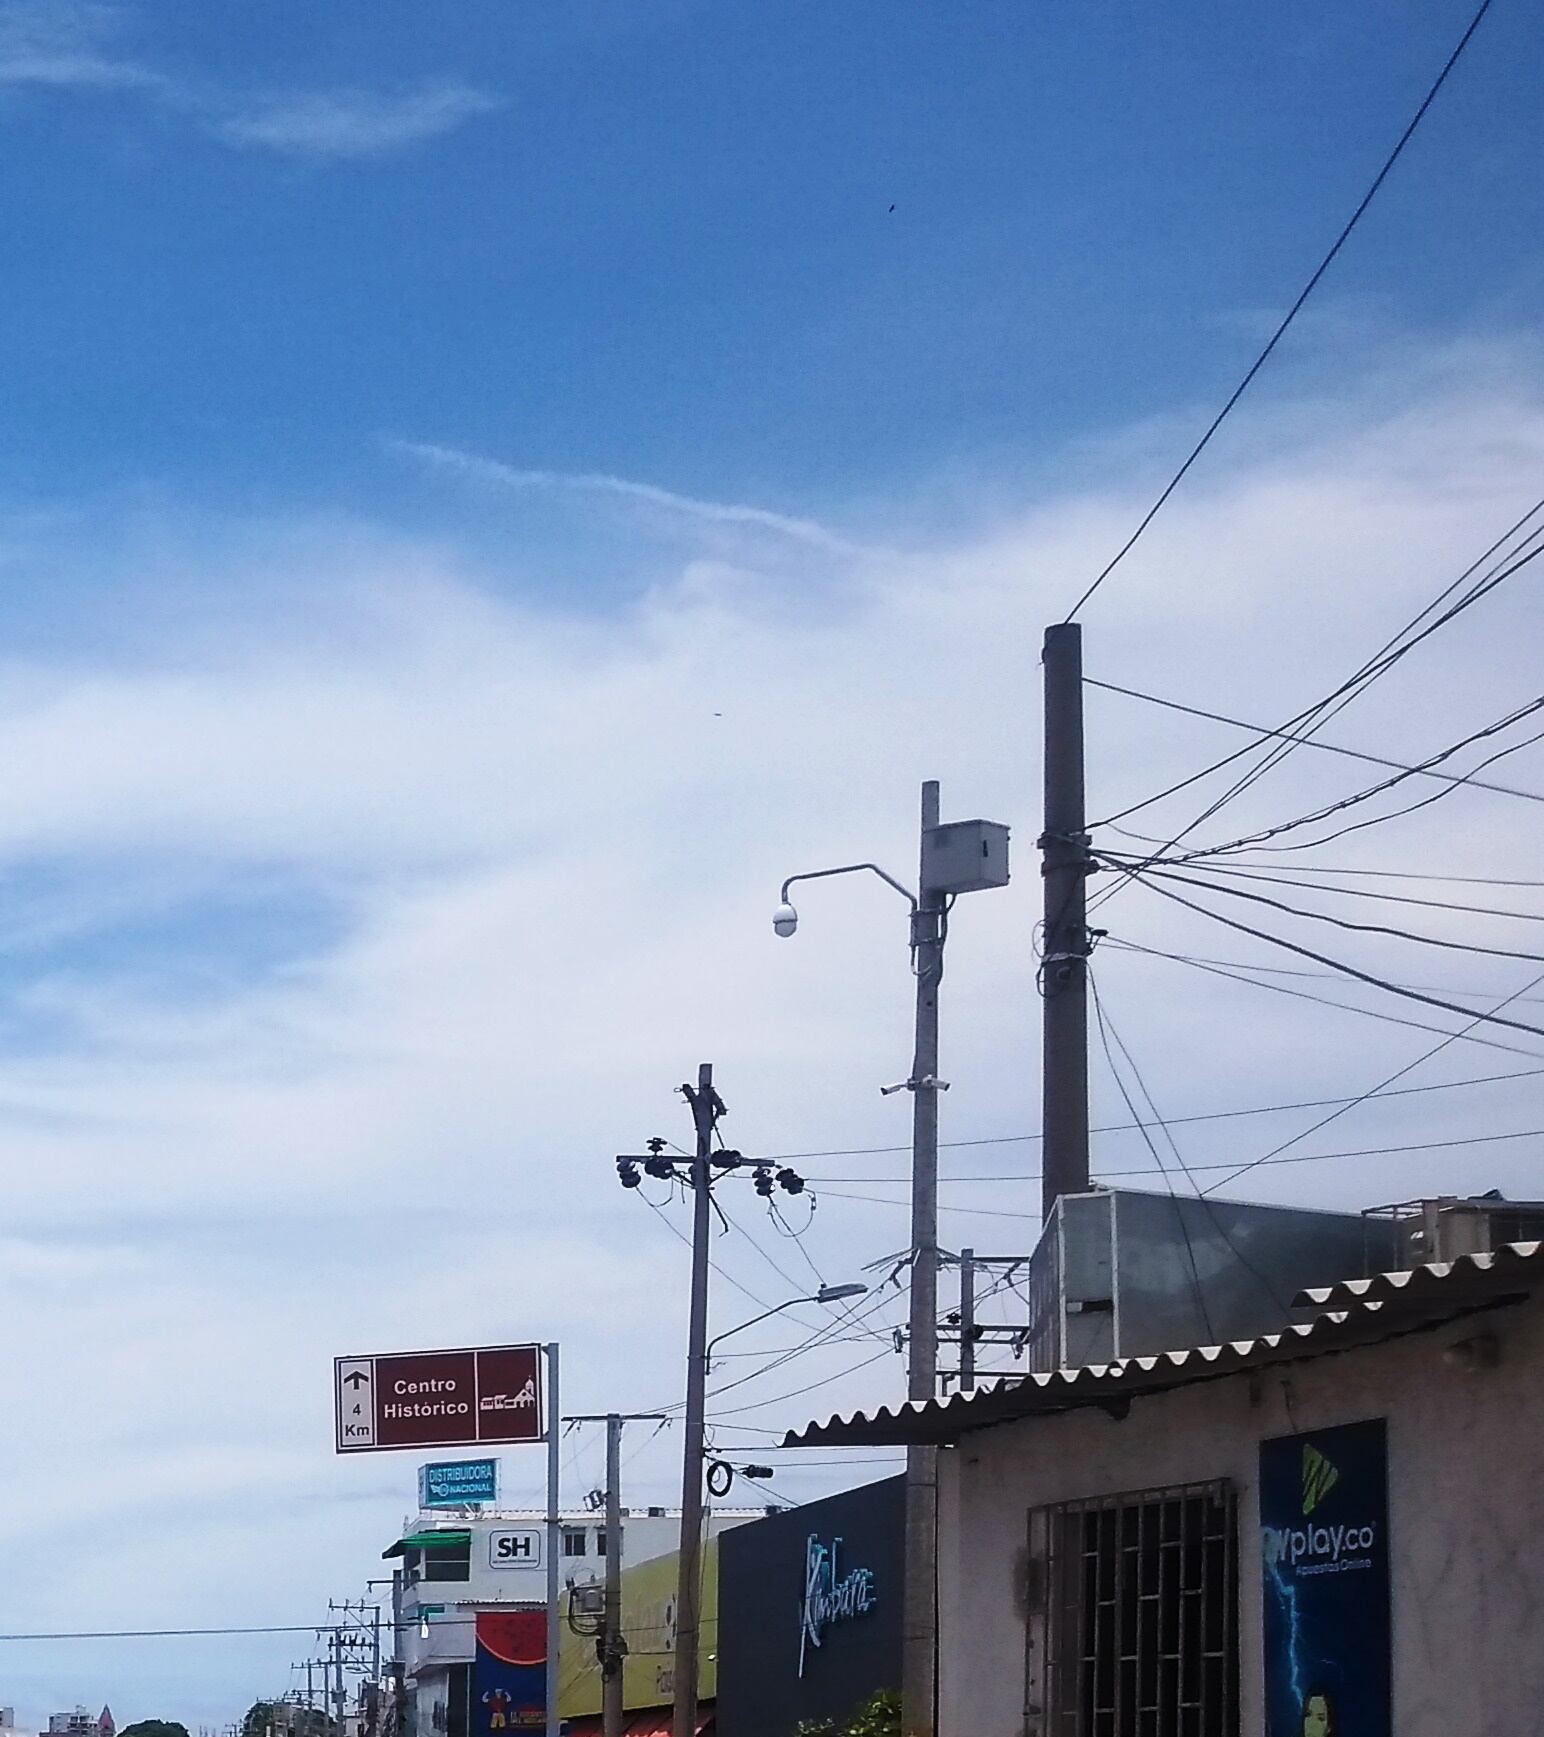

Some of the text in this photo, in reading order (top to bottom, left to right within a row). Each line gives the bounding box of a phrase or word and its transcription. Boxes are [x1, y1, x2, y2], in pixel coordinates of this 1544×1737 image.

[394, 1379, 456, 1395] Centro
[352, 1403, 362, 1416] 4
[384, 1402, 468, 1419] Histórico
[345, 1424, 370, 1437] Km
[429, 1465, 492, 1483] DISTRIBUIDORA
[450, 1483, 491, 1493] NACIONAL
[497, 1537, 530, 1557] SH
